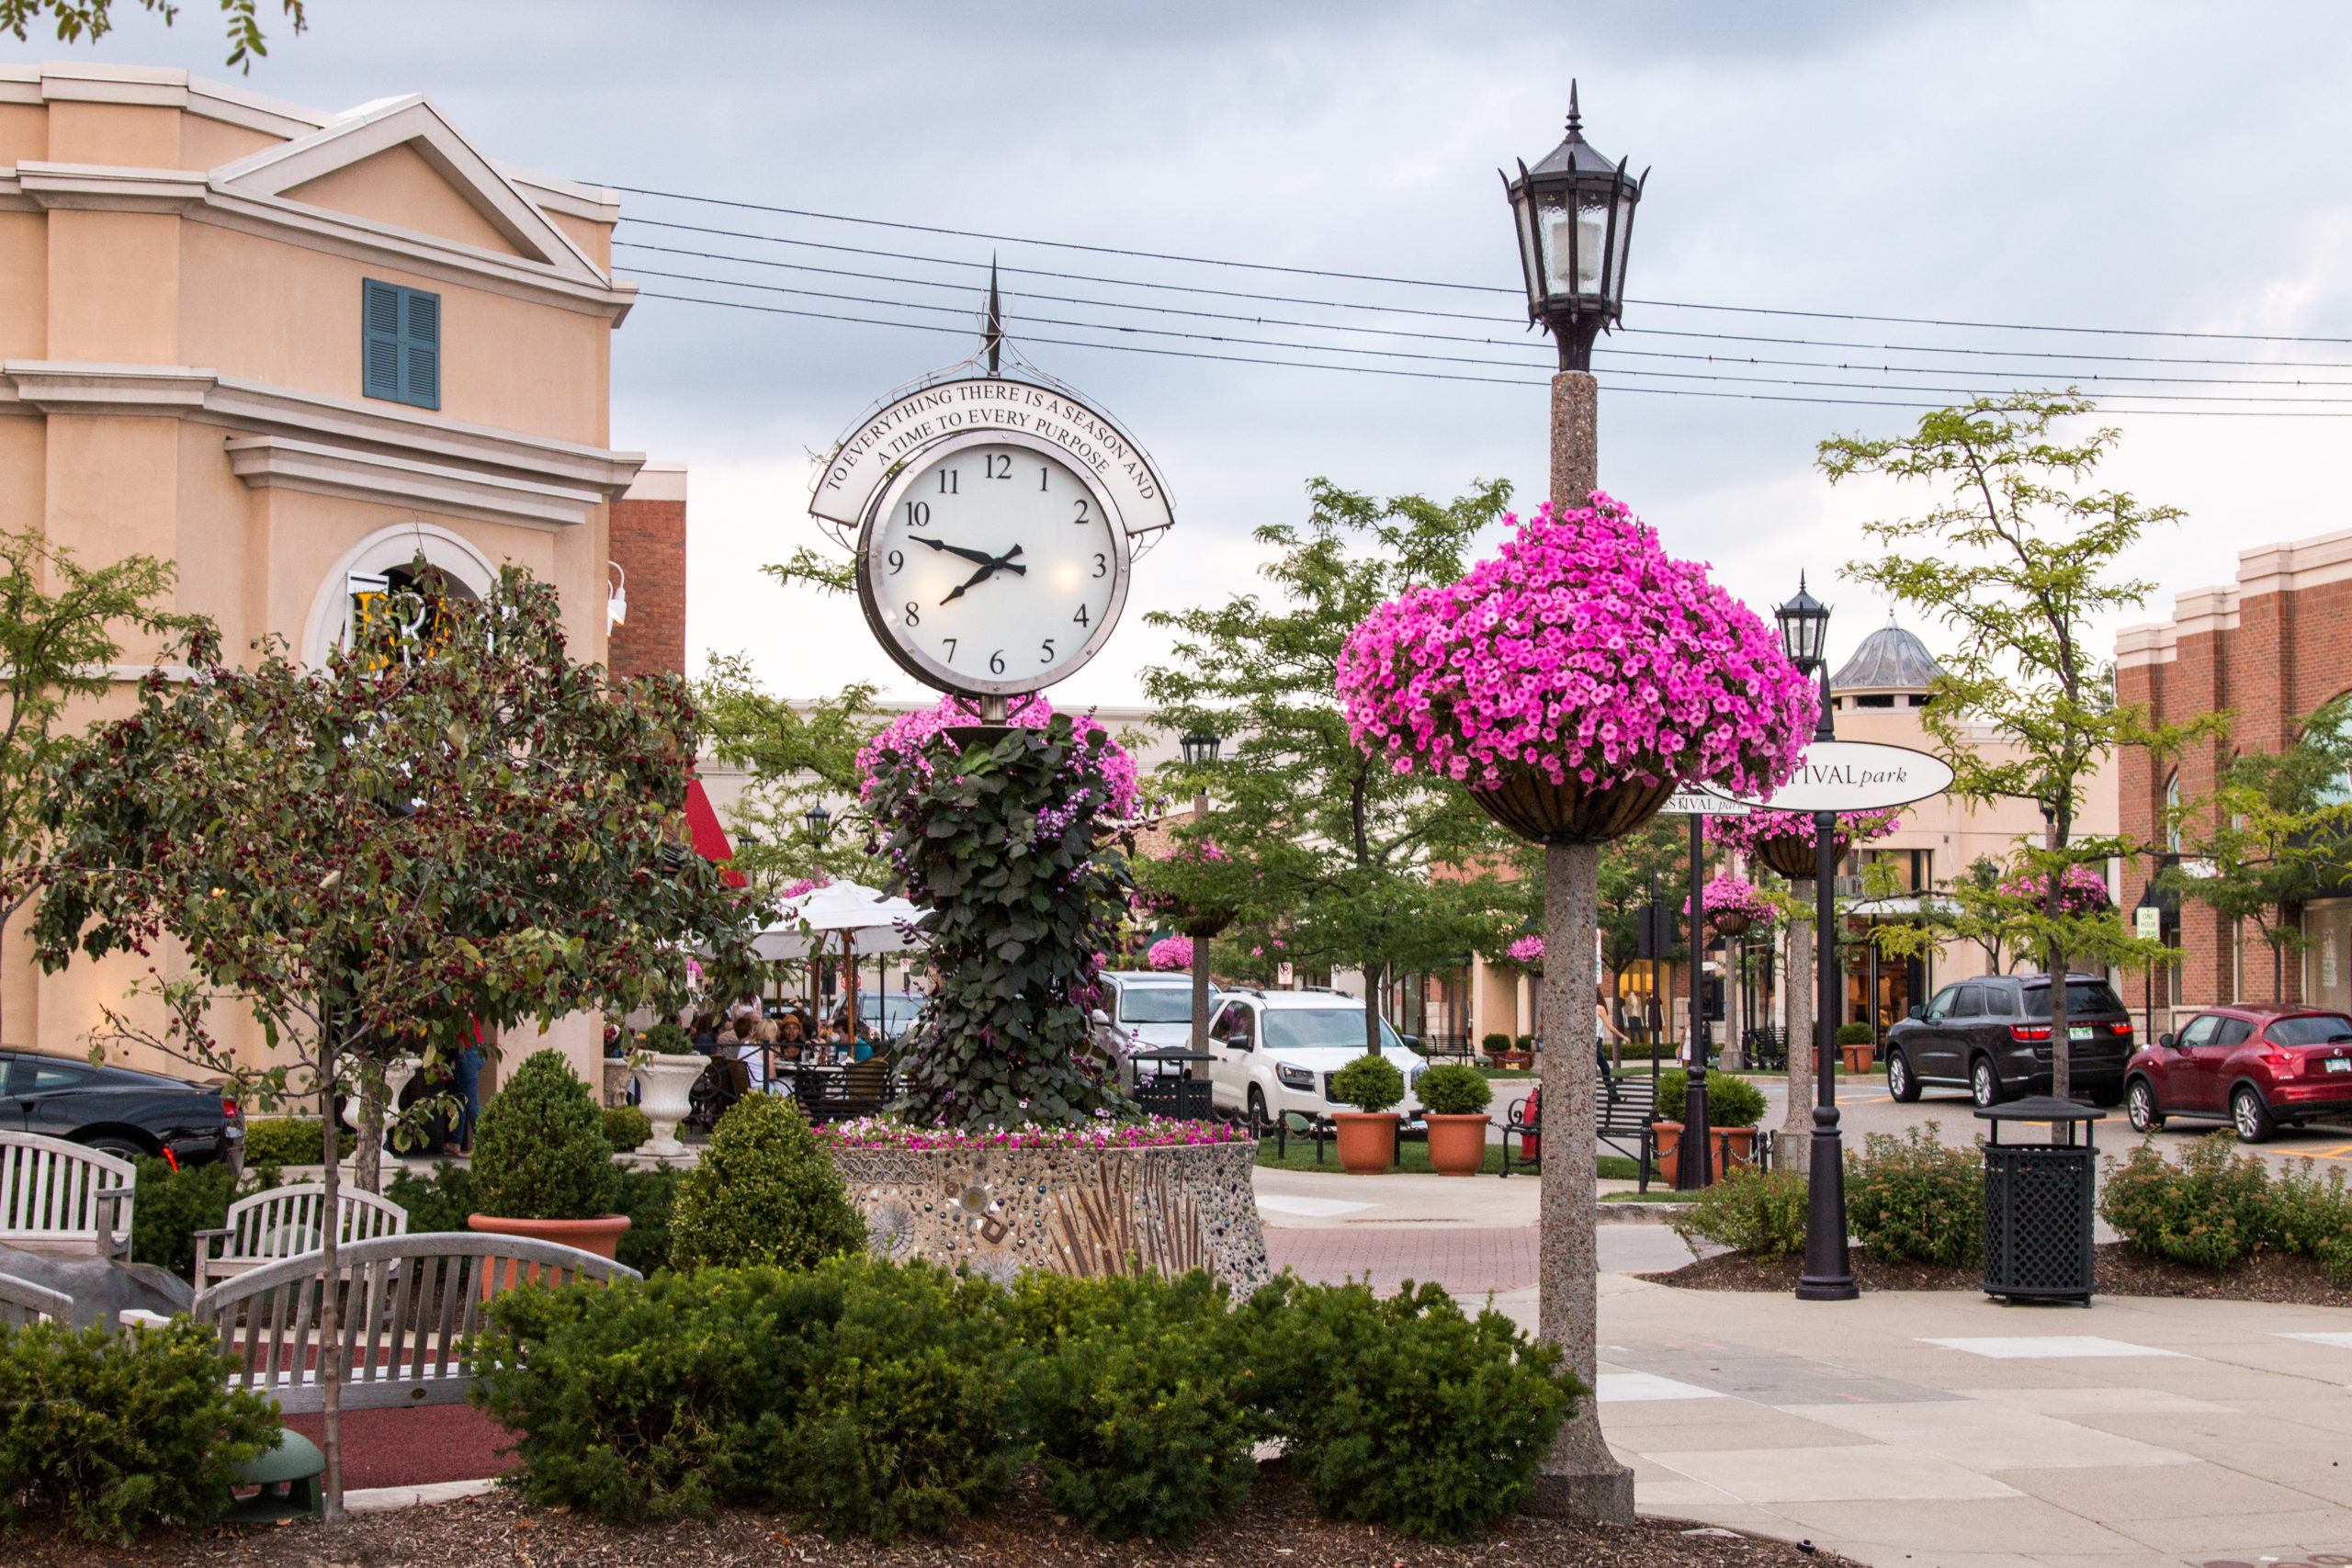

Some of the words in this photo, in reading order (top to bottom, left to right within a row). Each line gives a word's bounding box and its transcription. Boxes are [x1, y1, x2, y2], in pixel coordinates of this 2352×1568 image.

[827, 468, 848, 492] TO
[842, 389, 952, 467] EVERYTHING
[957, 385, 1020, 400] THERE
[1024, 390, 1044, 408] IS
[1046, 400, 1059, 414] A
[1062, 406, 1128, 459] SEASON
[1124, 461, 1154, 500] AND
[877, 451, 891, 466] A
[888, 422, 934, 454] TIME
[936, 412, 962, 430] TO
[968, 409, 1031, 427] EVERY
[1035, 417, 1110, 474] PURPOSE
[985, 454, 1012, 479] 12
[1040, 467, 1049, 491] 1
[938, 468, 959, 494] 11
[905, 501, 931, 527] 10
[1073, 499, 1090, 525] 2
[888, 550, 904, 575] 9
[1091, 553, 1106, 578] 3
[905, 602, 920, 626] 8
[1073, 604, 1090, 627] 4
[942, 638, 957, 663] 7
[989, 649, 1005, 674] 6
[1040, 638, 1055, 663] 5
[1790, 764, 1857, 784] TIVAL
[1859, 767, 1907, 787] park
